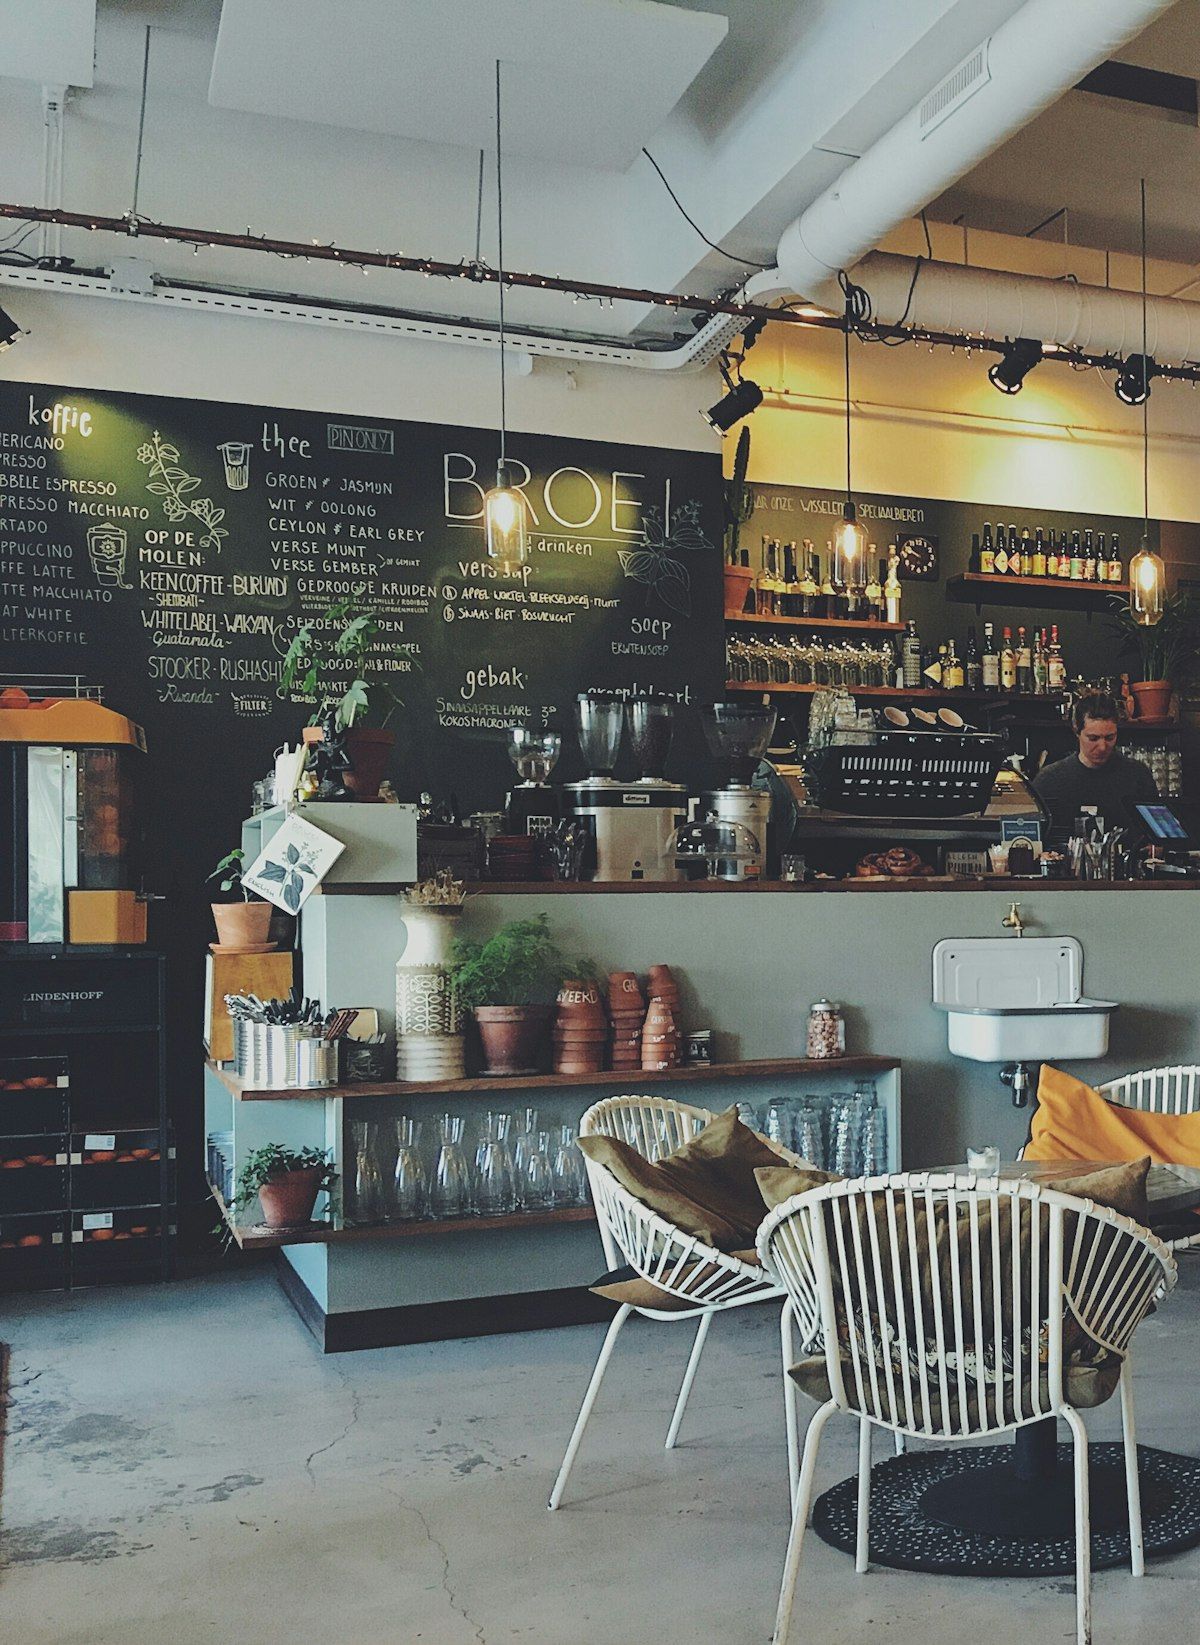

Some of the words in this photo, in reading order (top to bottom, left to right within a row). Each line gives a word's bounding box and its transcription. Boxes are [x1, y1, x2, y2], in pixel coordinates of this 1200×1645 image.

[29, 394, 93, 437] koffie
[0, 433, 65, 450] ERICANO
[261, 422, 312, 459] thee
[46, 477, 117, 496] ESPRESSO
[265, 471, 317, 490] GROEN
[68, 500, 149, 520] MACCHIATO
[268, 498, 296, 512] WIT
[320, 501, 377, 518] OOLONG
[144, 529, 170, 545] OP
[174, 531, 196, 547] DE
[269, 517, 326, 535] CEYLON
[350, 525, 382, 540] EARL
[388, 528, 425, 543] GREY
[0, 540, 73, 559] PPUCCINO
[270, 540, 320, 555] VERSE
[327, 543, 367, 558] MUNT
[537, 538, 593, 556] drinken
[1, 561, 25, 575] FFE
[33, 564, 76, 580] LATTE
[270, 558, 316, 572] VERSE
[322, 560, 379, 577] GEMBER
[1, 582, 27, 597] TTE
[33, 585, 113, 603] MACCHIATO
[382, 582, 437, 599] KRUIDEN
[2, 604, 19, 618] AT
[25, 606, 73, 623] WHITE
[2, 627, 88, 645] LTERKOFFIE
[631, 617, 672, 640] soep
[240, 700, 267, 710] FILTER
[23, 991, 104, 1001] LINDENHOFF
